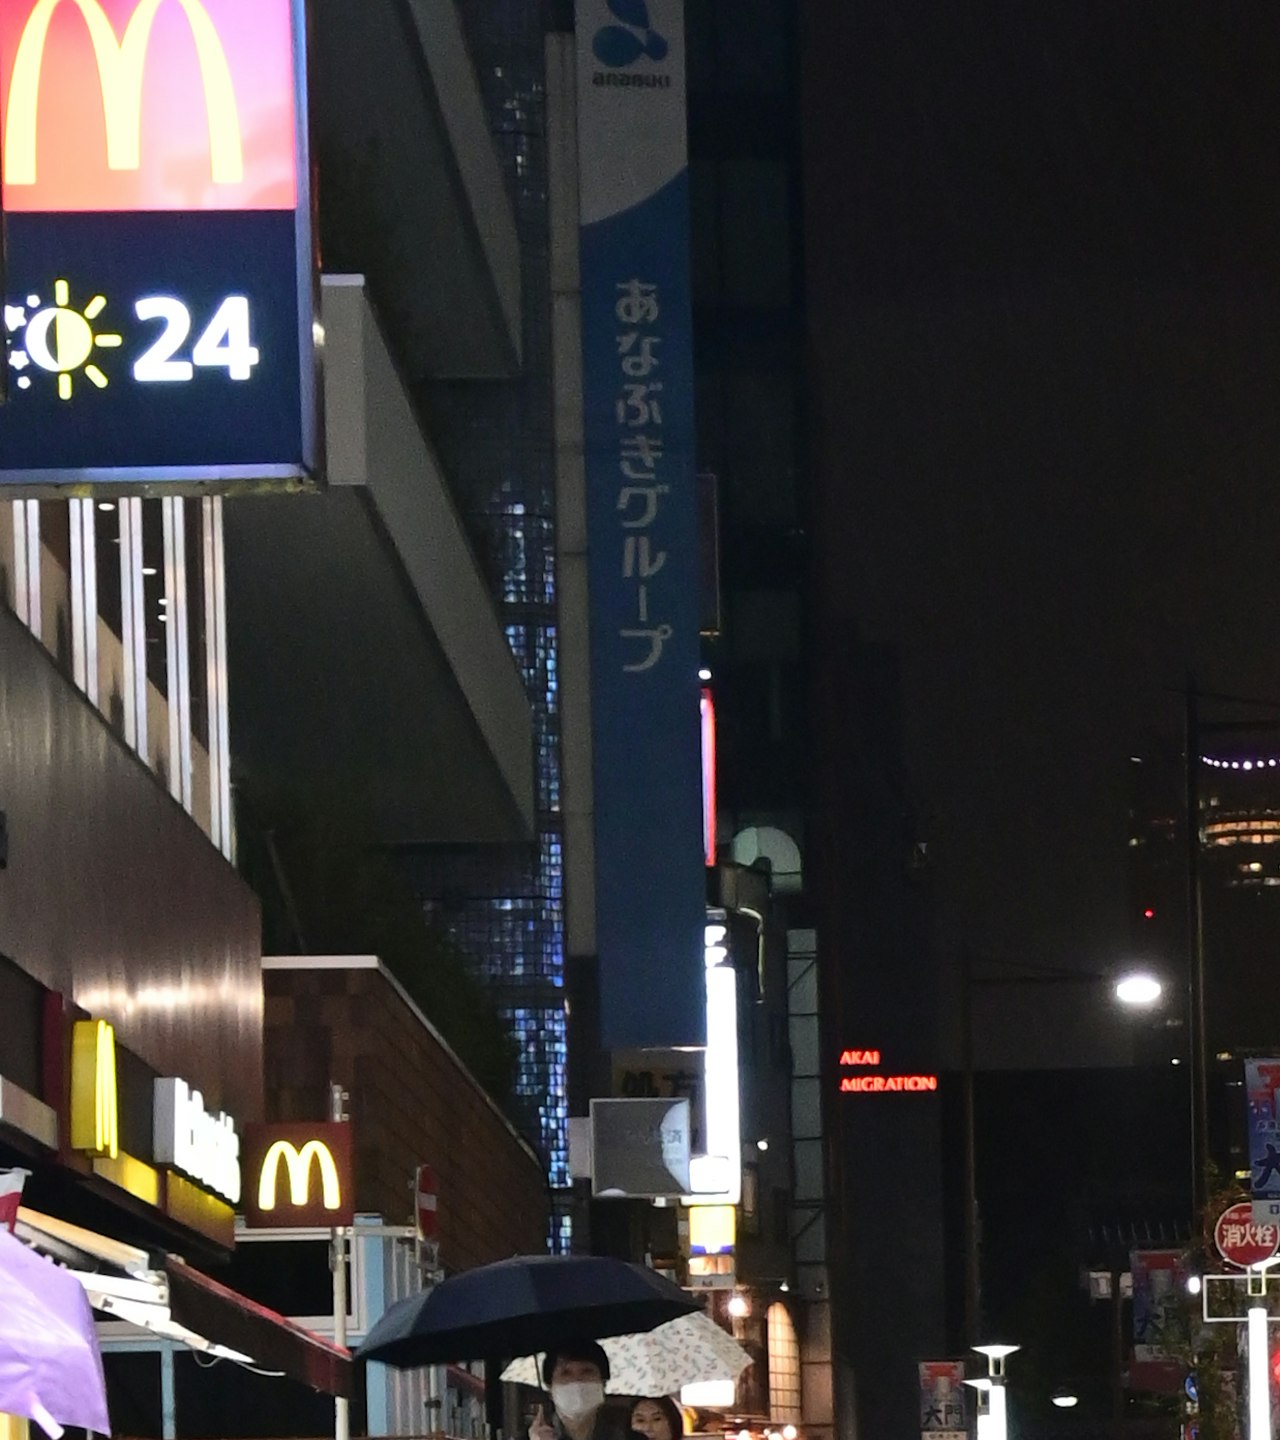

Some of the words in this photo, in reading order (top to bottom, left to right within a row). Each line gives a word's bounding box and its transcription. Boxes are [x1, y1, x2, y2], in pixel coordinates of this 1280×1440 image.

[133, 295, 260, 383] 24
[614, 277, 673, 674] あなぶきグループ
[839, 1050, 881, 1066] AKAI
[840, 1075, 938, 1092] MIGRATION
[1221, 1222, 1275, 1248] 消火栓
[923, 1404, 964, 1427] 大門
